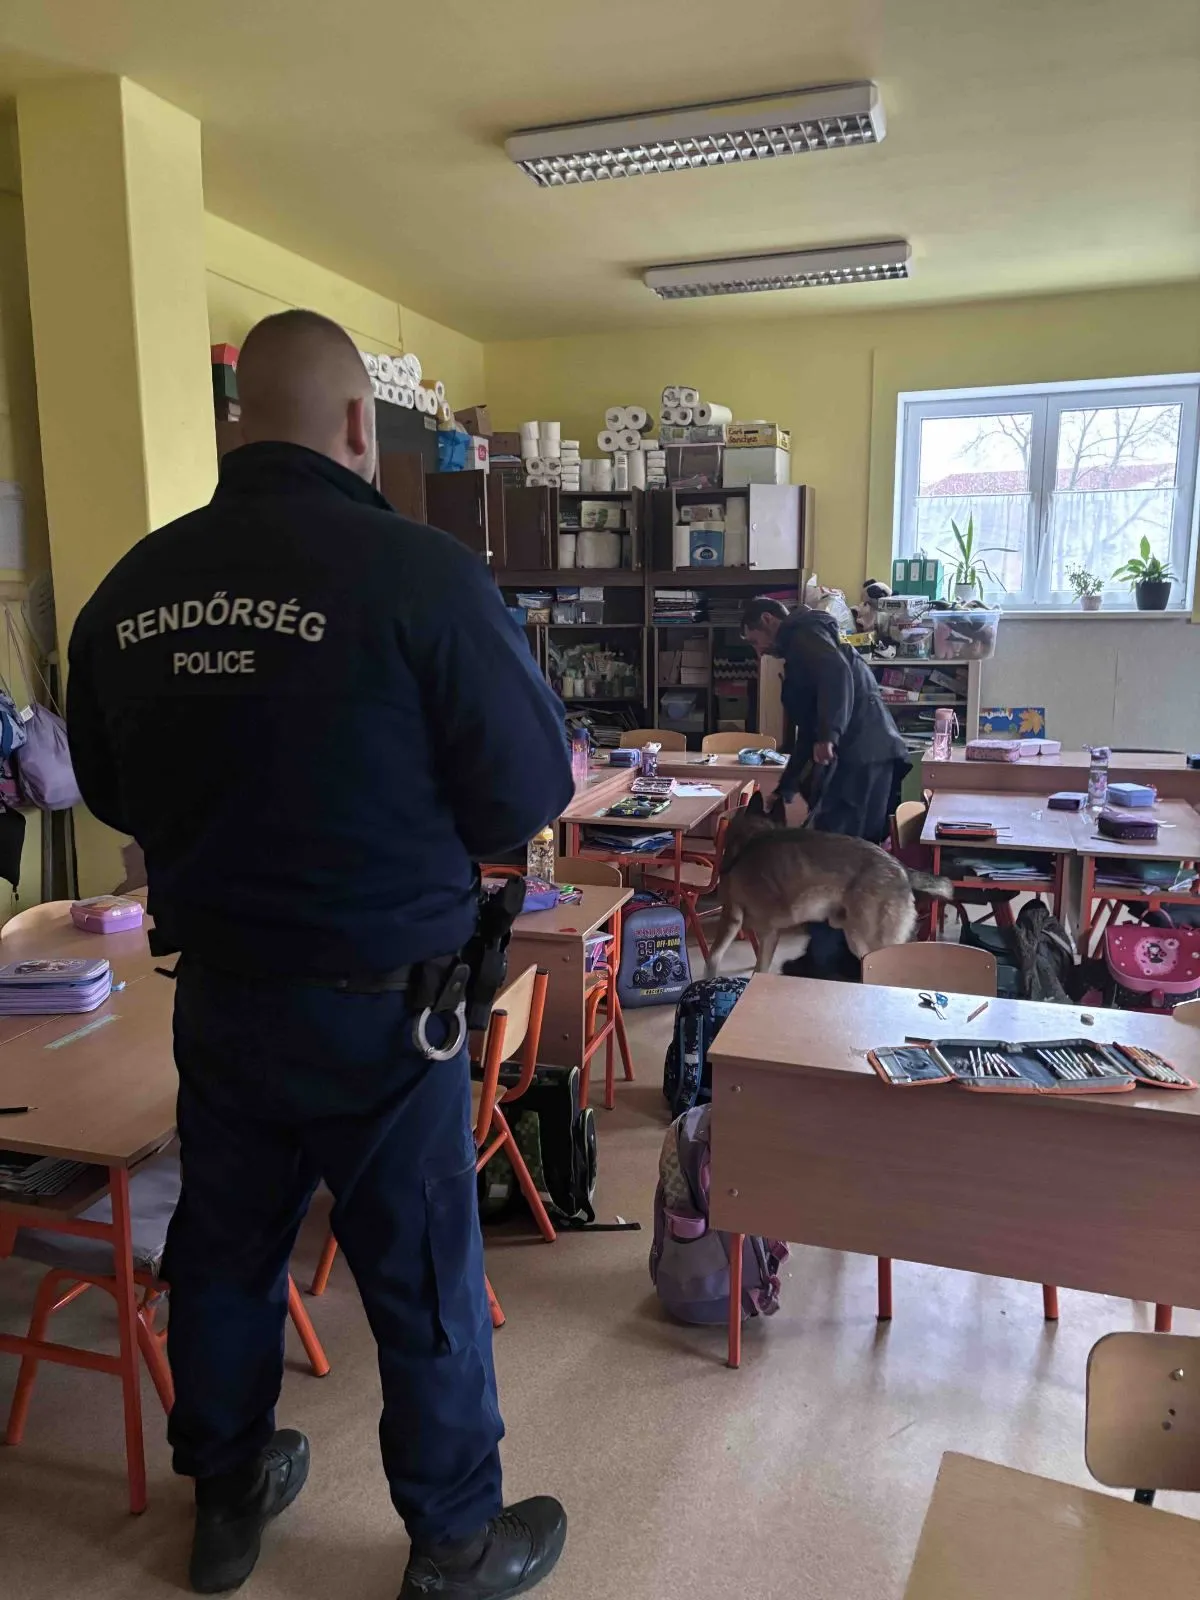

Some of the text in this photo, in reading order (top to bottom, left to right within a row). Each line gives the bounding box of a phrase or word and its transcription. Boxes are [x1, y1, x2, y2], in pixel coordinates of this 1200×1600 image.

[115, 591, 327, 650] RENDŐRSÉG
[173, 651, 256, 675] POLICE
[637, 940, 655, 956] 89
